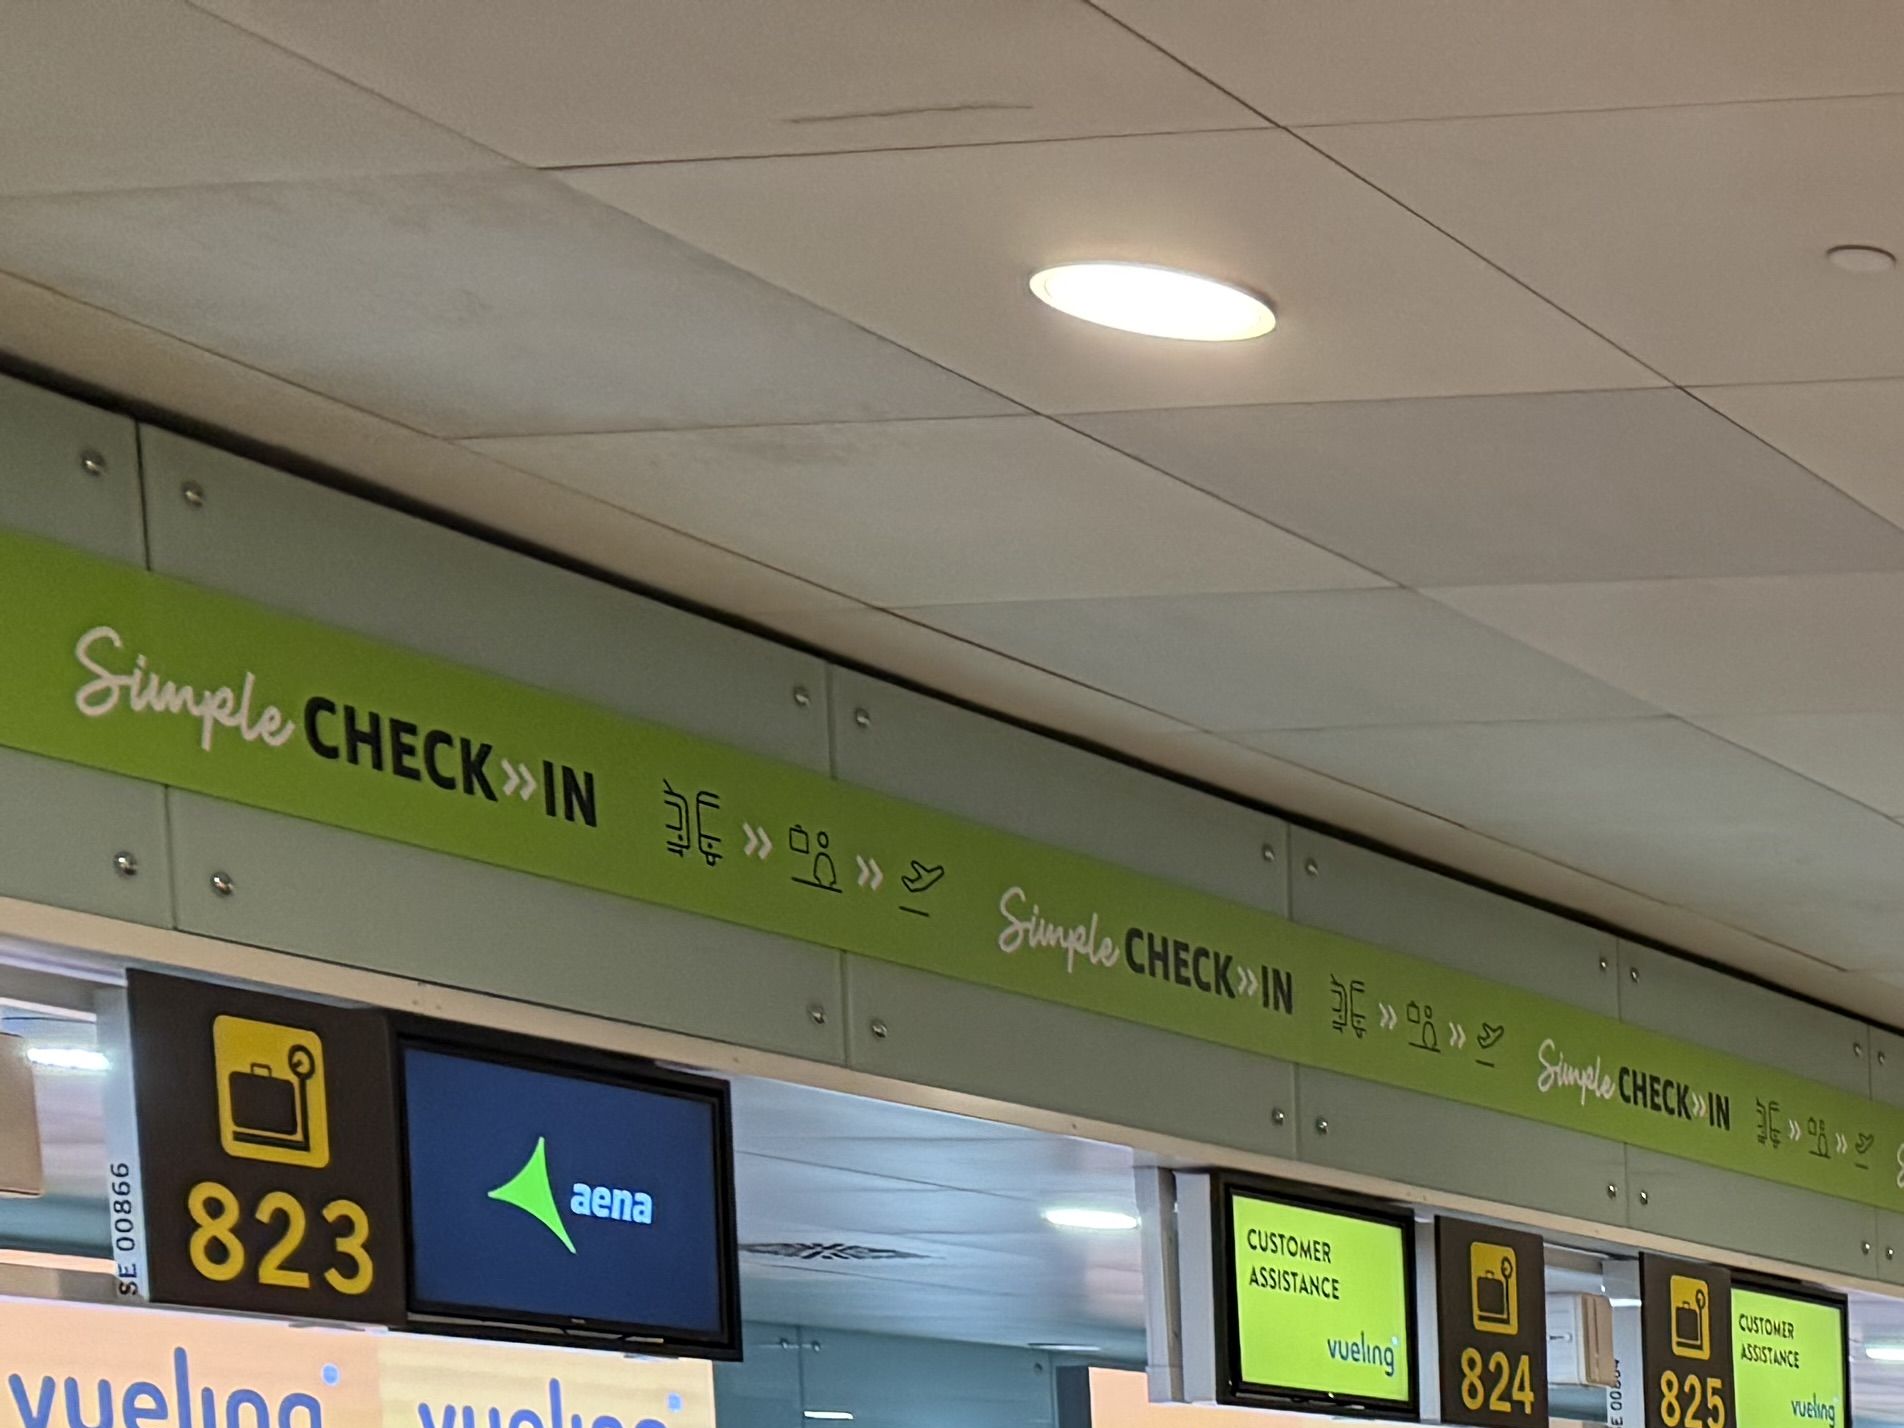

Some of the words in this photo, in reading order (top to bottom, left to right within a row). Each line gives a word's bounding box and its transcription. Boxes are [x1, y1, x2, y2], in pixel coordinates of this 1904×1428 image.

[75, 626, 294, 750] Simple
[999, 887, 1120, 974] Simple
[1538, 1039, 1615, 1106] Simple
[110, 1161, 135, 1254] 00866
[570, 1180, 652, 1225] aena
[187, 1181, 374, 1295] 823
[1247, 1228, 1332, 1266] CUSTOMER
[117, 1262, 137, 1296] SE
[1249, 1264, 1340, 1302] ASSISTANCE
[1738, 1313, 1795, 1341] CUSTOMER
[1327, 1331, 1396, 1377] vueling
[1740, 1342, 1800, 1370] ASSISTANCE
[1460, 1347, 1535, 1415] 824
